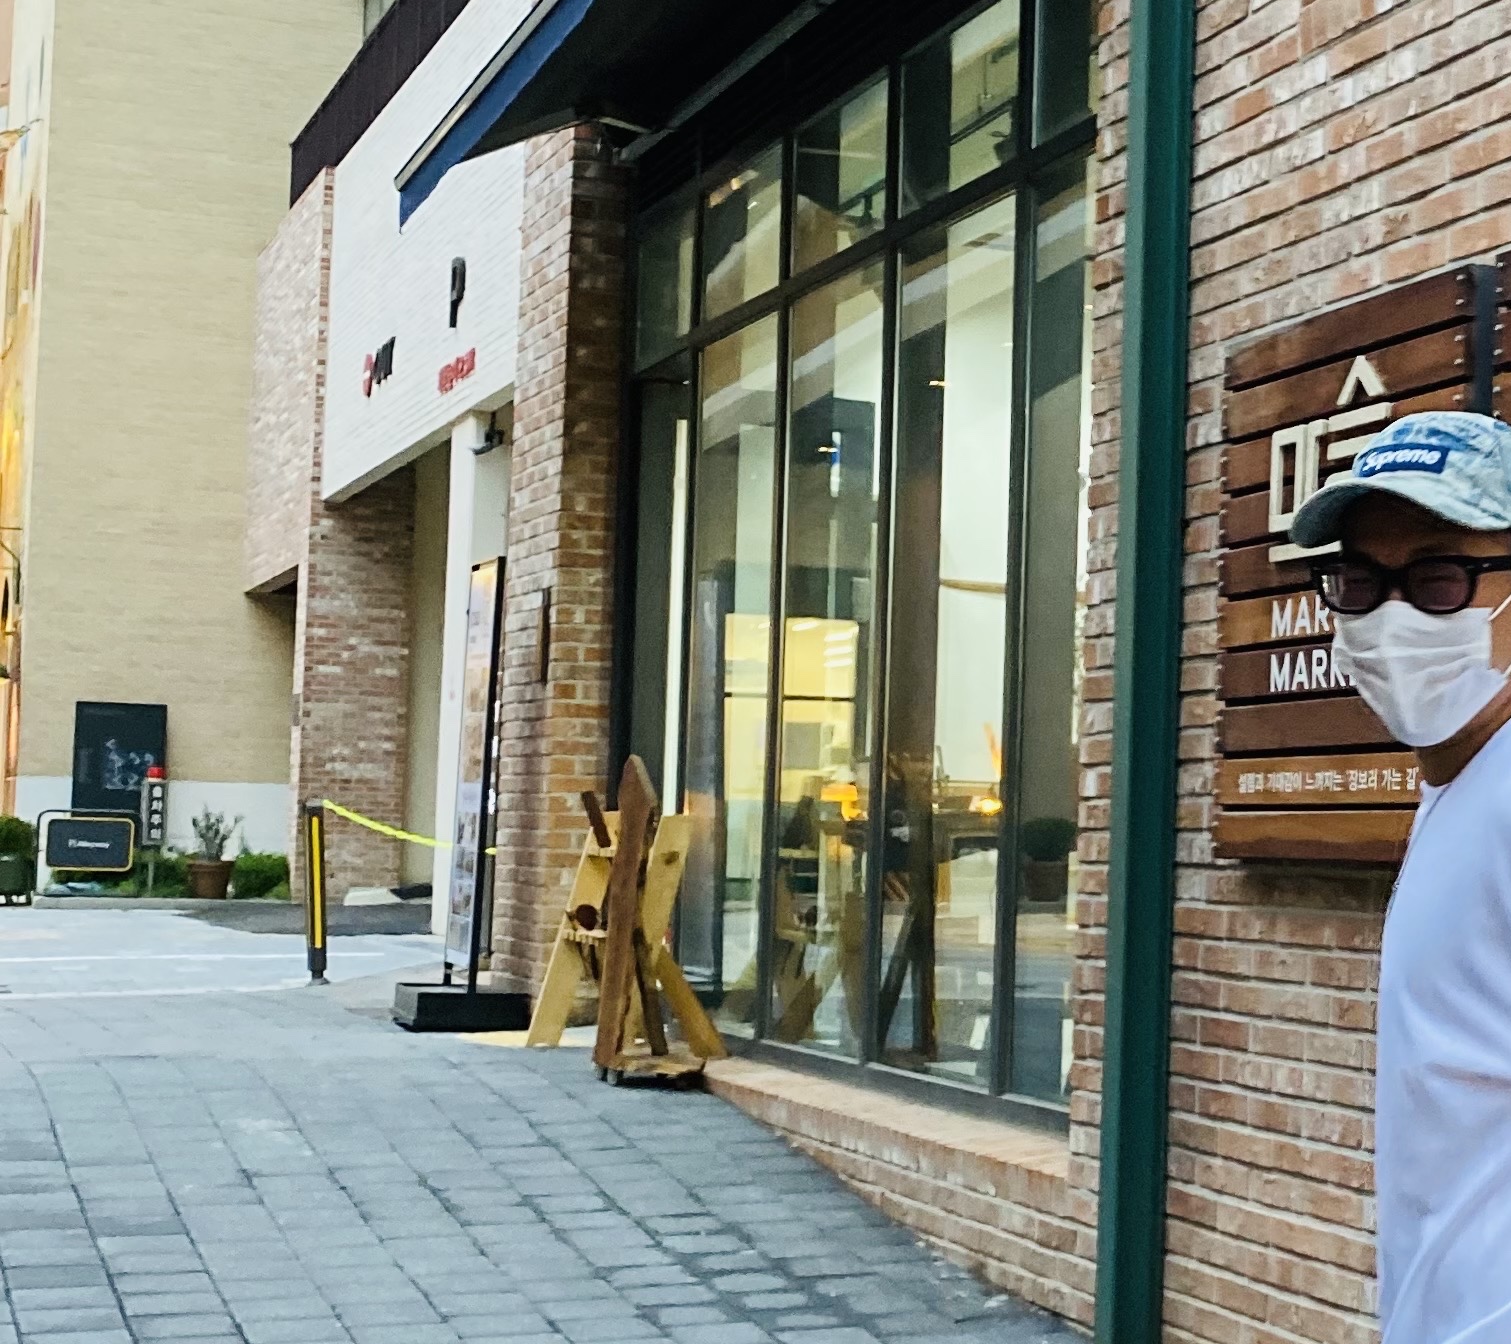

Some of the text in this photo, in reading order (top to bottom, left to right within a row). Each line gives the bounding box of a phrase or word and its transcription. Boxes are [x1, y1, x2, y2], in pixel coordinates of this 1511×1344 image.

[449, 256, 467, 328] P
[1271, 594, 1338, 638] MAR
[1269, 648, 1357, 693] MARK
[1381, 767, 1402, 791] 가는
